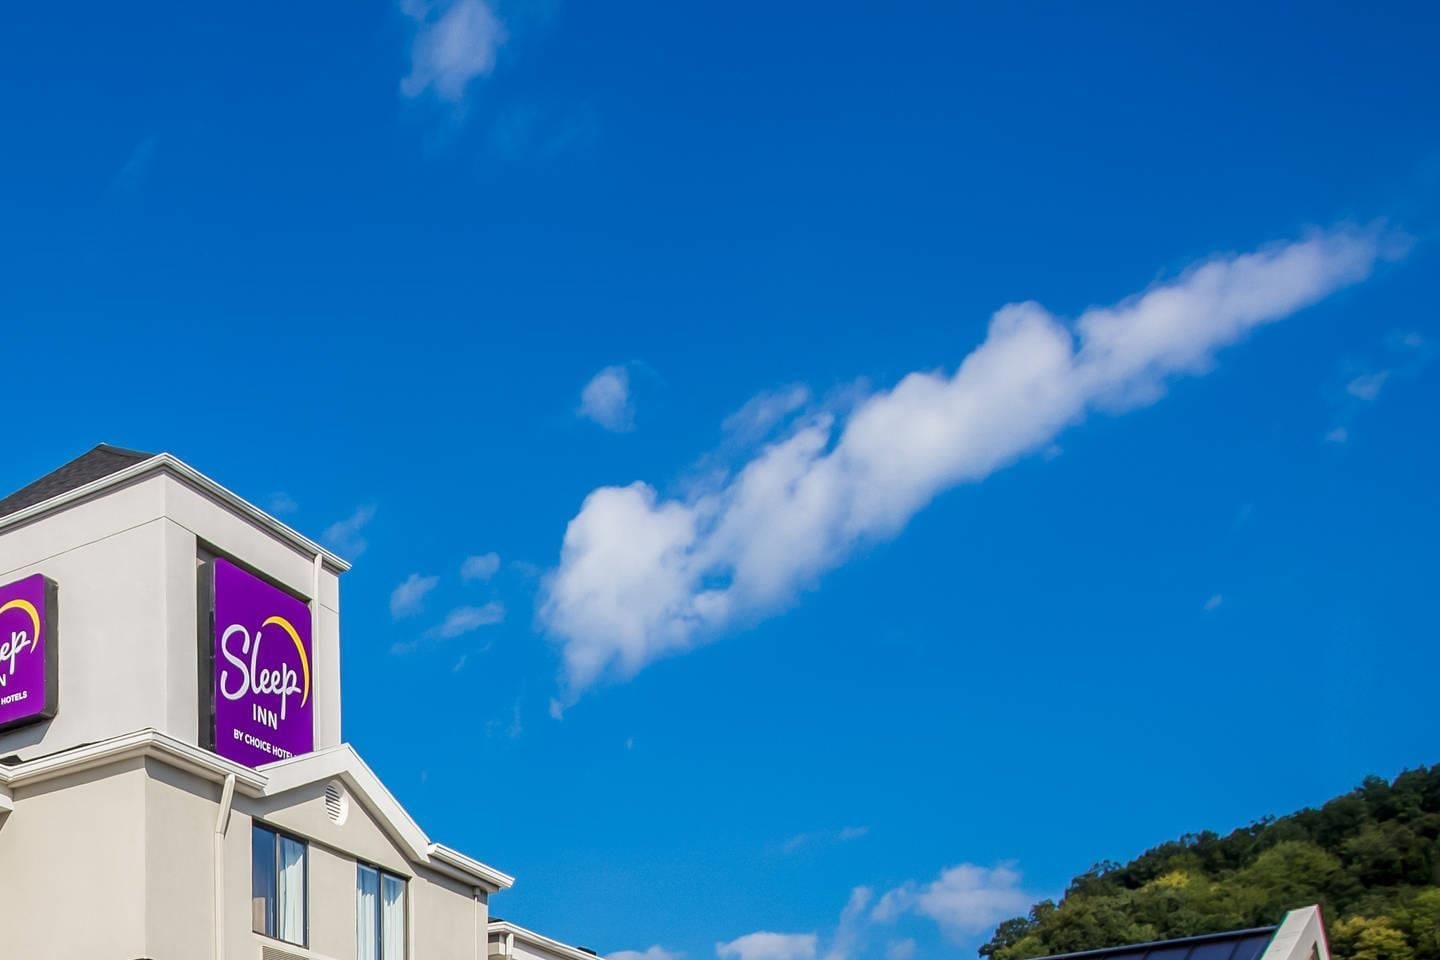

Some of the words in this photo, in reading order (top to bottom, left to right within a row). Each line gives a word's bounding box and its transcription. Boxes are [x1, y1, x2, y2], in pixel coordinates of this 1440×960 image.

[220, 624, 302, 721] Sleep
[1, 691, 27, 705] HOTELS
[252, 703, 278, 731] INN
[233, 728, 244, 741] BY
[244, 733, 271, 753] CHOICE
